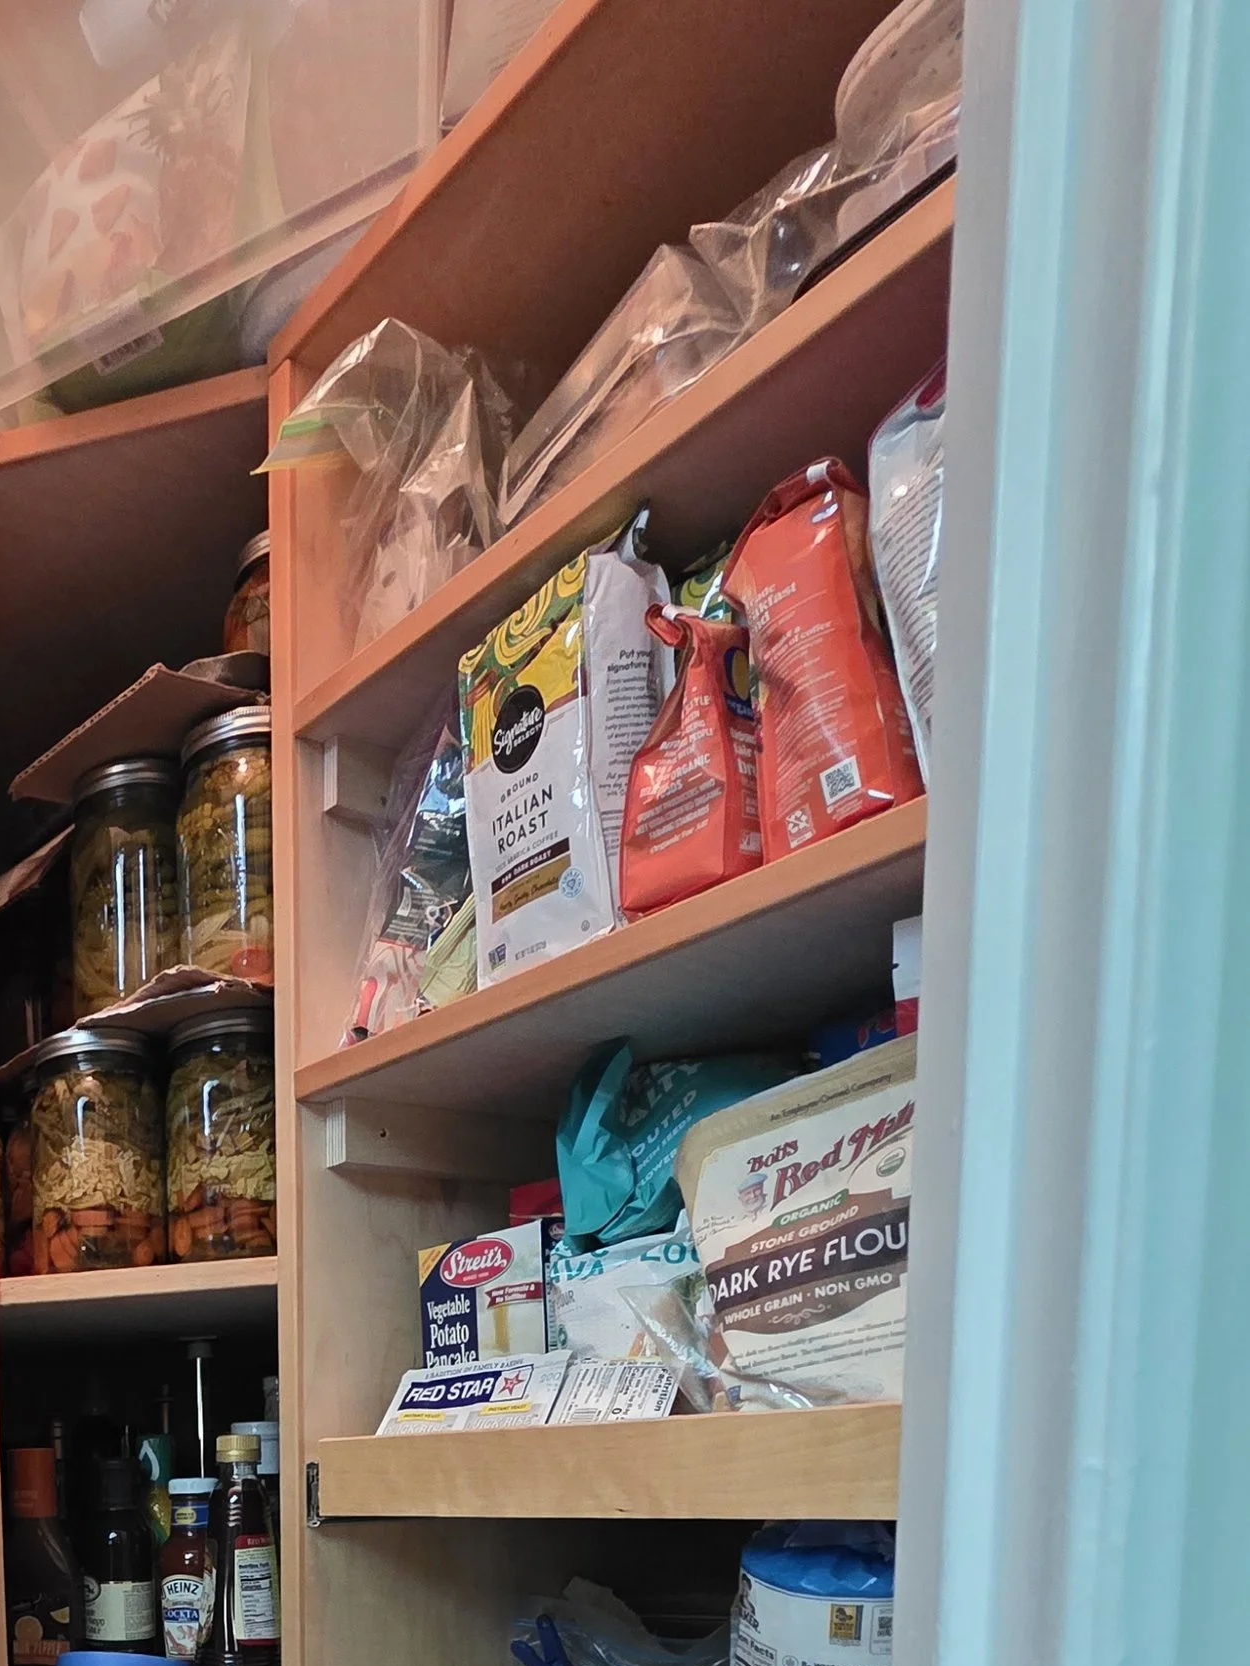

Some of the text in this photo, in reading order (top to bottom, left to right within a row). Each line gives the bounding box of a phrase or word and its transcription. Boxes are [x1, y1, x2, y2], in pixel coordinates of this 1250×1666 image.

[494, 705, 542, 757] Signature
[500, 772, 539, 803] GROUND
[492, 784, 553, 837] ITALIAN
[498, 810, 549, 854] ROAST
[747, 1139, 799, 1173] Bob's
[770, 1135, 845, 1212] Red
[779, 1193, 843, 1226] ORGANIC
[750, 1230, 795, 1254] STONE
[798, 1205, 859, 1238] GROUND
[443, 1245, 508, 1277] Streit's
[708, 1268, 758, 1302] DARK
[767, 1247, 814, 1284] RYE
[427, 1294, 471, 1325] Vegetable
[723, 1272, 893, 1325] WHOLE GRAIN NON GMO
[430, 1323, 470, 1348] Potato
[425, 1350, 477, 1369] Pancake
[472, 1362, 499, 1372] FAMILY
[405, 1377, 495, 1402] RED STAR
[654, 1373, 673, 1412] utrition
[166, 1582, 200, 1595] HEINZ
[750, 1639, 775, 1661] Facts
